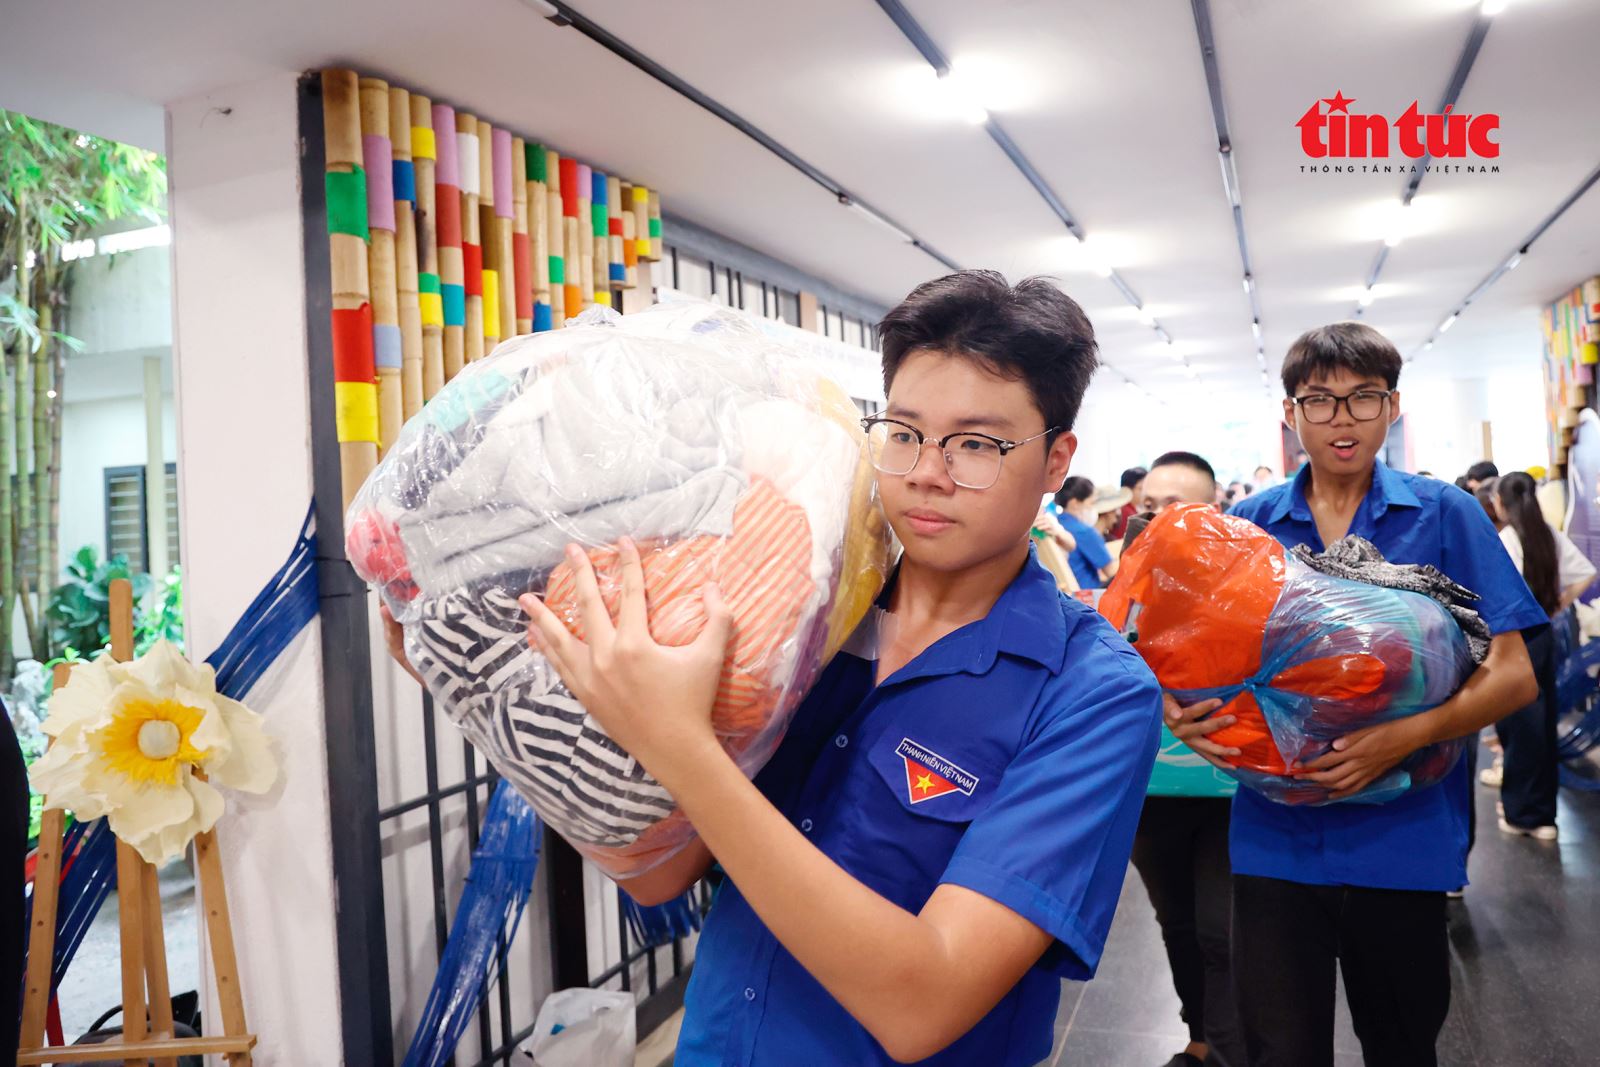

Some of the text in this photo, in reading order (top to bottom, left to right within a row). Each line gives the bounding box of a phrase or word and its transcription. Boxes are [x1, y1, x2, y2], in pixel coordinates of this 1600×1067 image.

[901, 742, 974, 790] THANH NIÊN VIỆT NAM
